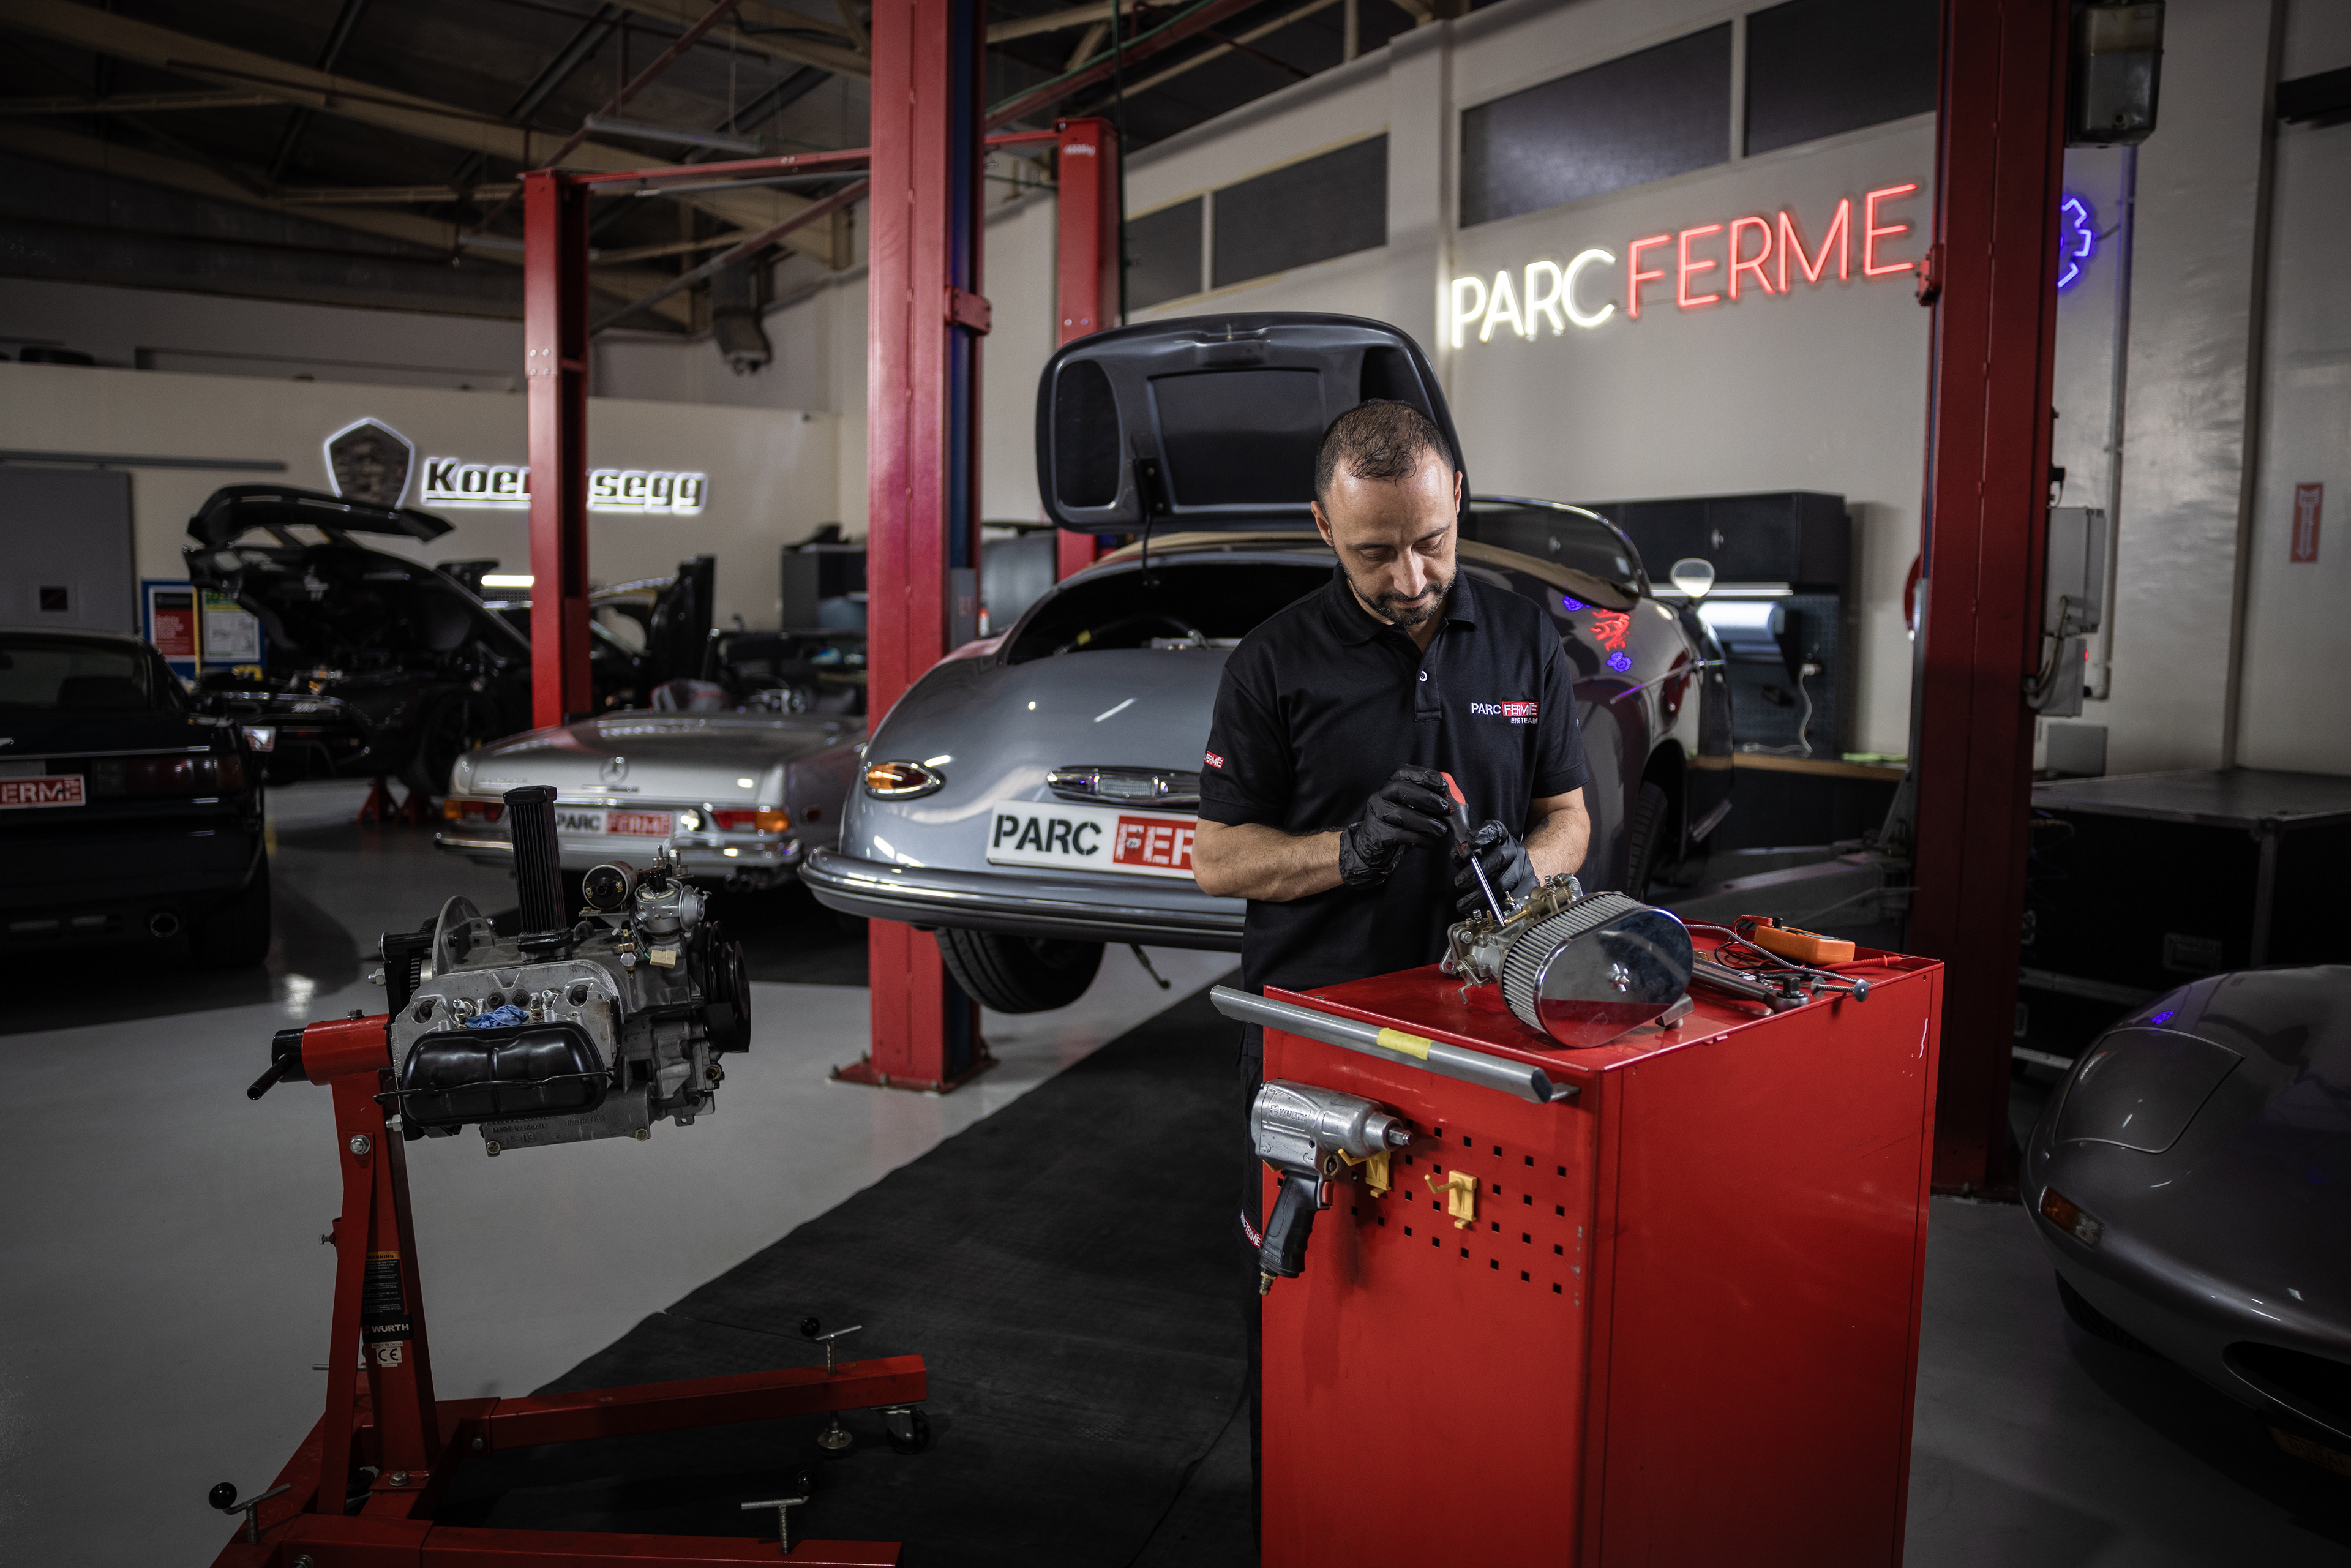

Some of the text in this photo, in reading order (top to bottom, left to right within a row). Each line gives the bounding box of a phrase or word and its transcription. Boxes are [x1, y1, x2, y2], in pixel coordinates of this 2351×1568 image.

[1451, 183, 1918, 348] PARC FERME
[1471, 702, 1501, 715] PARC
[556, 813, 601, 831] PARC
[993, 814, 1196, 866] PARC FER
[378, 1348, 399, 1362] CE
